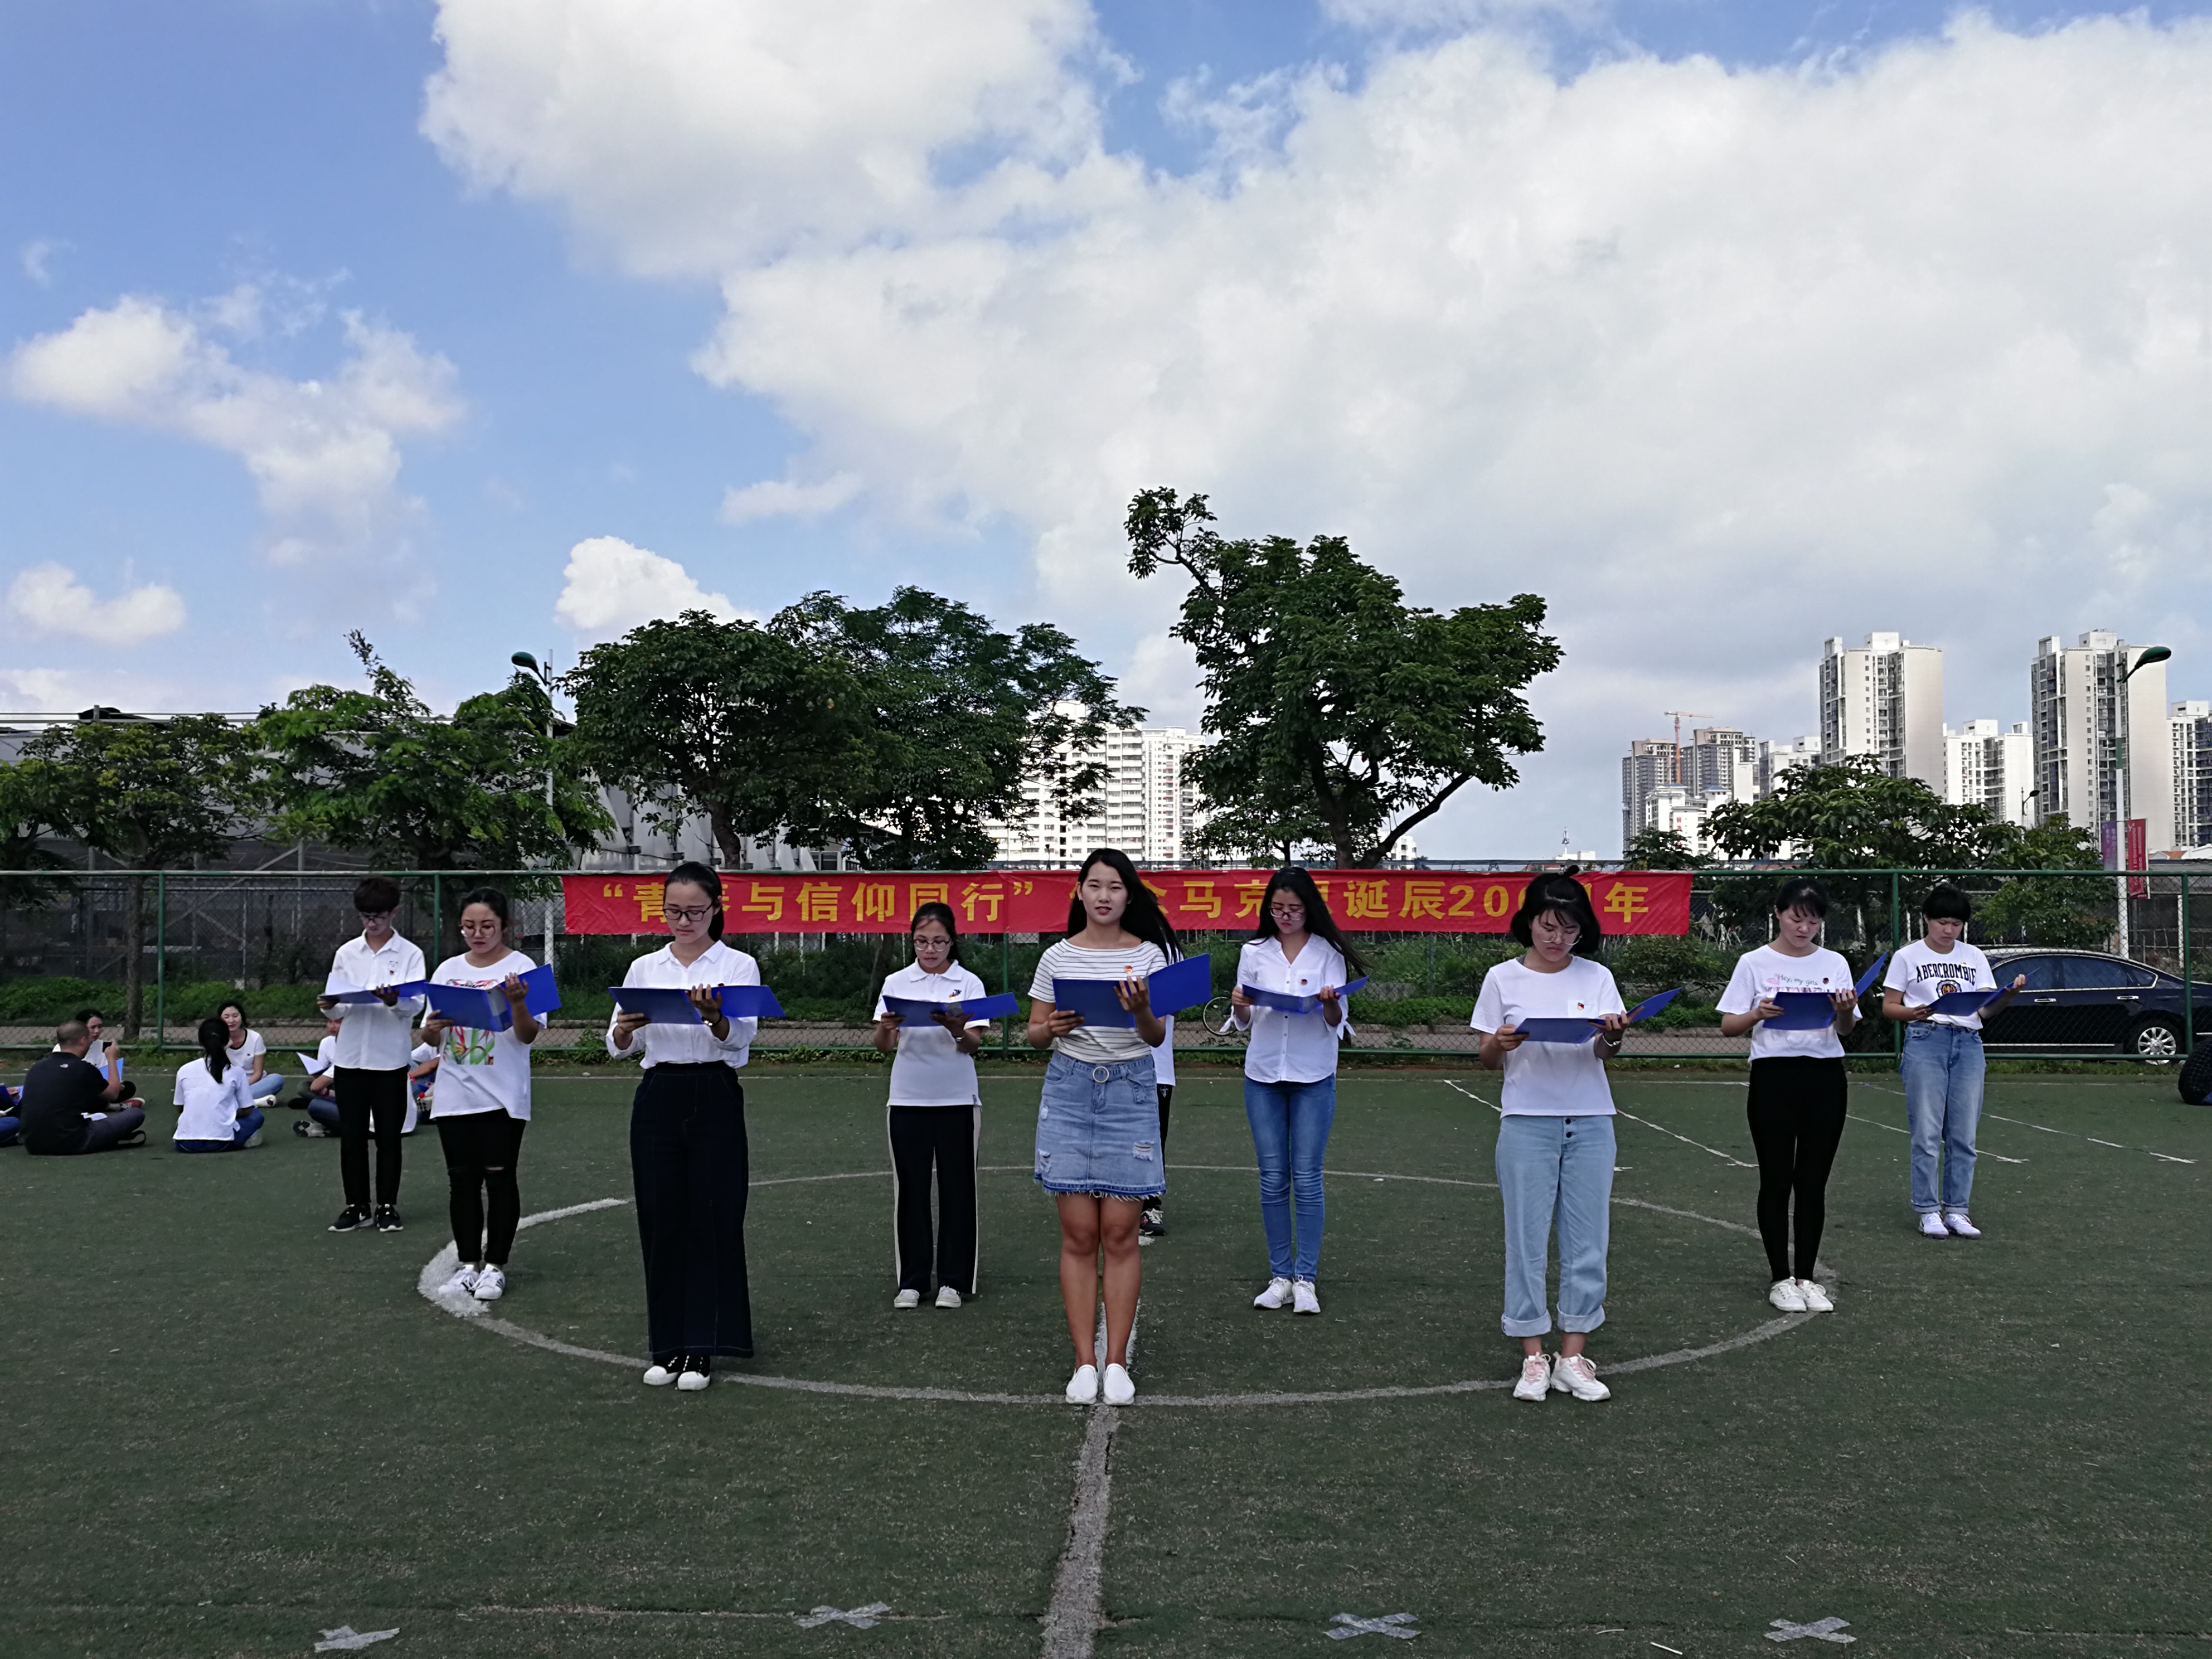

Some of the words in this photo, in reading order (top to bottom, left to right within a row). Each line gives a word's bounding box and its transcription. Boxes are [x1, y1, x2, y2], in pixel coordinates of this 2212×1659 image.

[603, 881, 1033, 923] “青与信仰同行”
[1916, 963, 1976, 986] ABERCROMBIE
